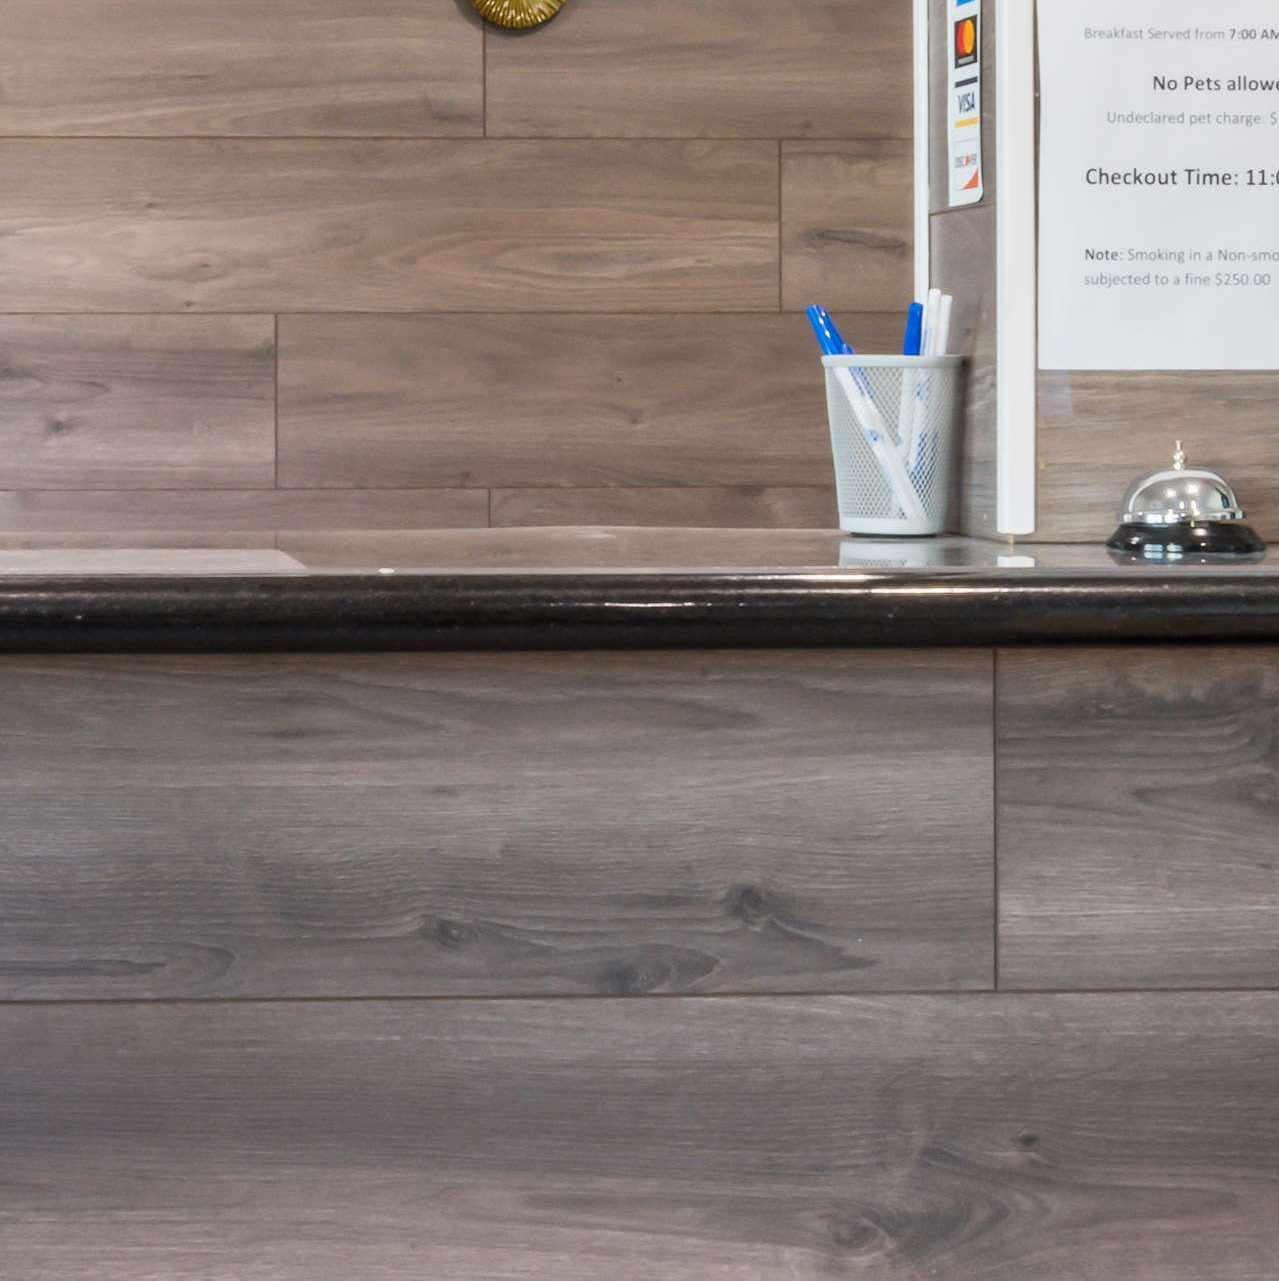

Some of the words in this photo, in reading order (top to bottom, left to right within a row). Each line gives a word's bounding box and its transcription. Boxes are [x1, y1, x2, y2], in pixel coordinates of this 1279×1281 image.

[1084, 27, 1143, 40] Breakfast
[1147, 27, 1191, 40] Served
[1194, 28, 1226, 40] from
[1228, 28, 1258, 40] 7:00
[1152, 75, 1178, 91] No
[1183, 75, 1222, 92] Pets
[957, 91, 976, 114] VISA
[1106, 110, 1185, 126] Undeclared
[1188, 112, 1212, 128] pet
[1215, 111, 1265, 128] charge:
[1085, 167, 1178, 186] Checkout
[1183, 167, 1239, 186] Time:
[1084, 248, 1123, 262] Note:
[1127, 247, 1186, 265] Smoking
[1188, 248, 1202, 261] in
[1205, 251, 1213, 262] a
[1083, 271, 1151, 288] subjected
[1152, 273, 1169, 287] to
[1172, 275, 1181, 286] a
[1184, 272, 1212, 287] fine
[1214, 271, 1272, 287] $250.00
